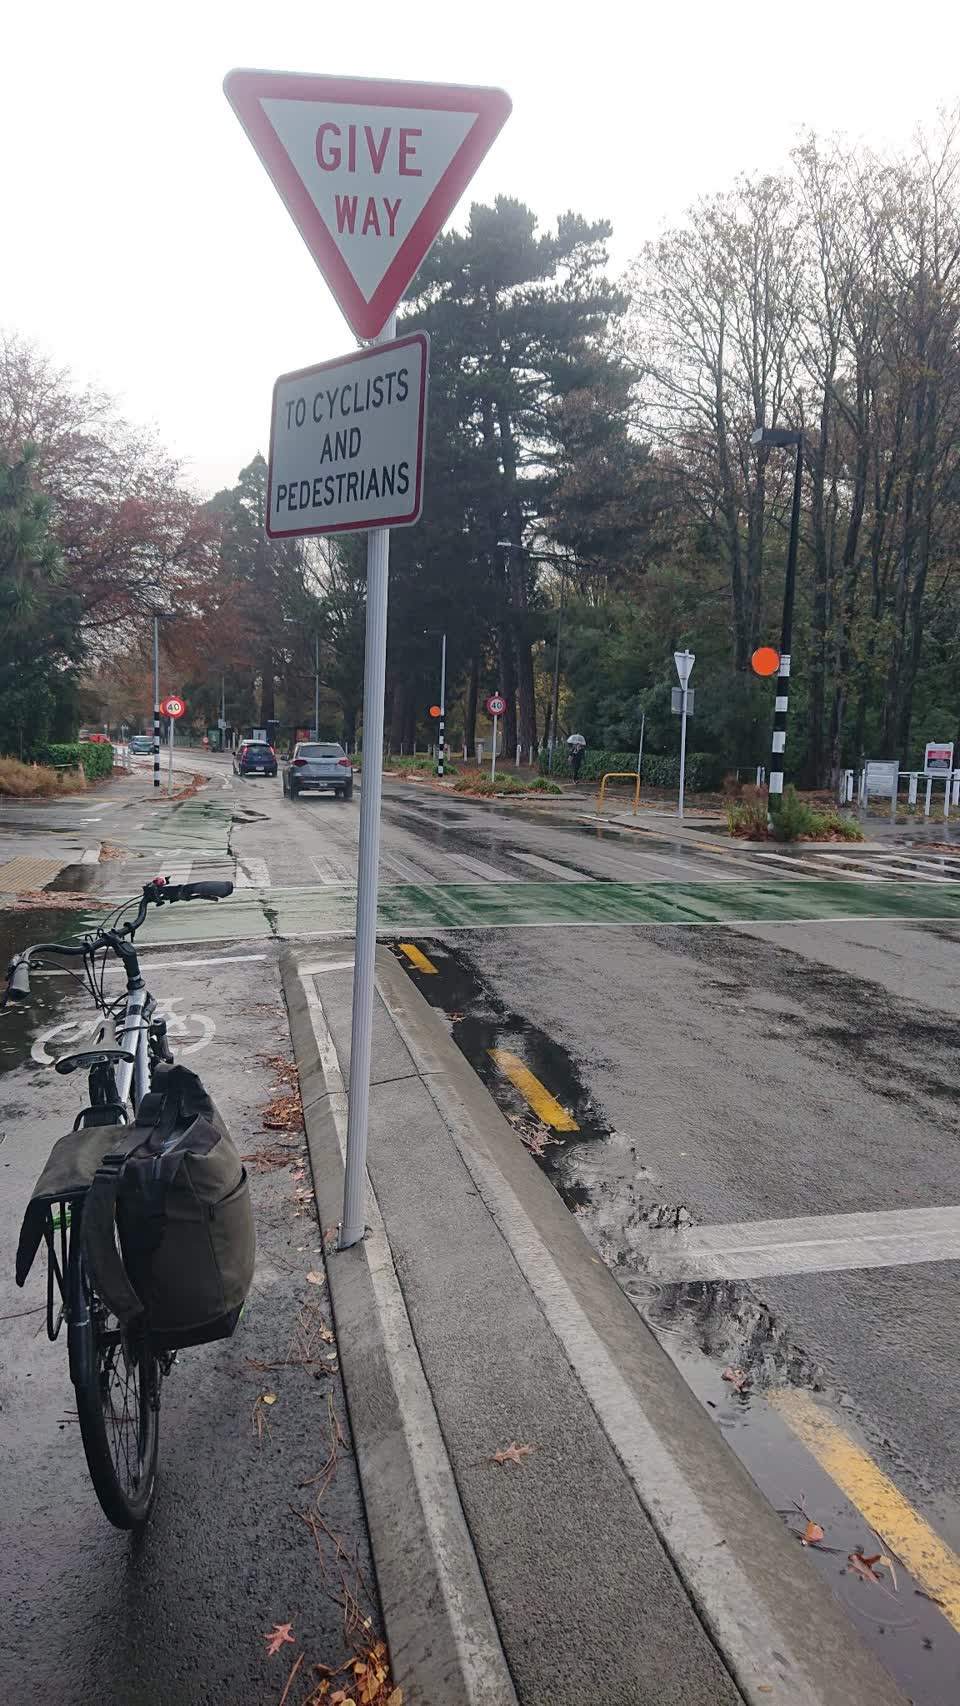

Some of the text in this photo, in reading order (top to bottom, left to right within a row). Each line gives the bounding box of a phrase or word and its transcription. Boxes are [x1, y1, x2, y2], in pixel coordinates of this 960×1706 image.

[315, 122, 423, 177] GIVE
[334, 194, 402, 238] WAY
[285, 368, 409, 430] TO CYCLISTS
[320, 427, 362, 465] AND
[276, 462, 410, 513] PEDESTRIANS
[168, 703, 180, 711] 40
[491, 701, 503, 709] 40
